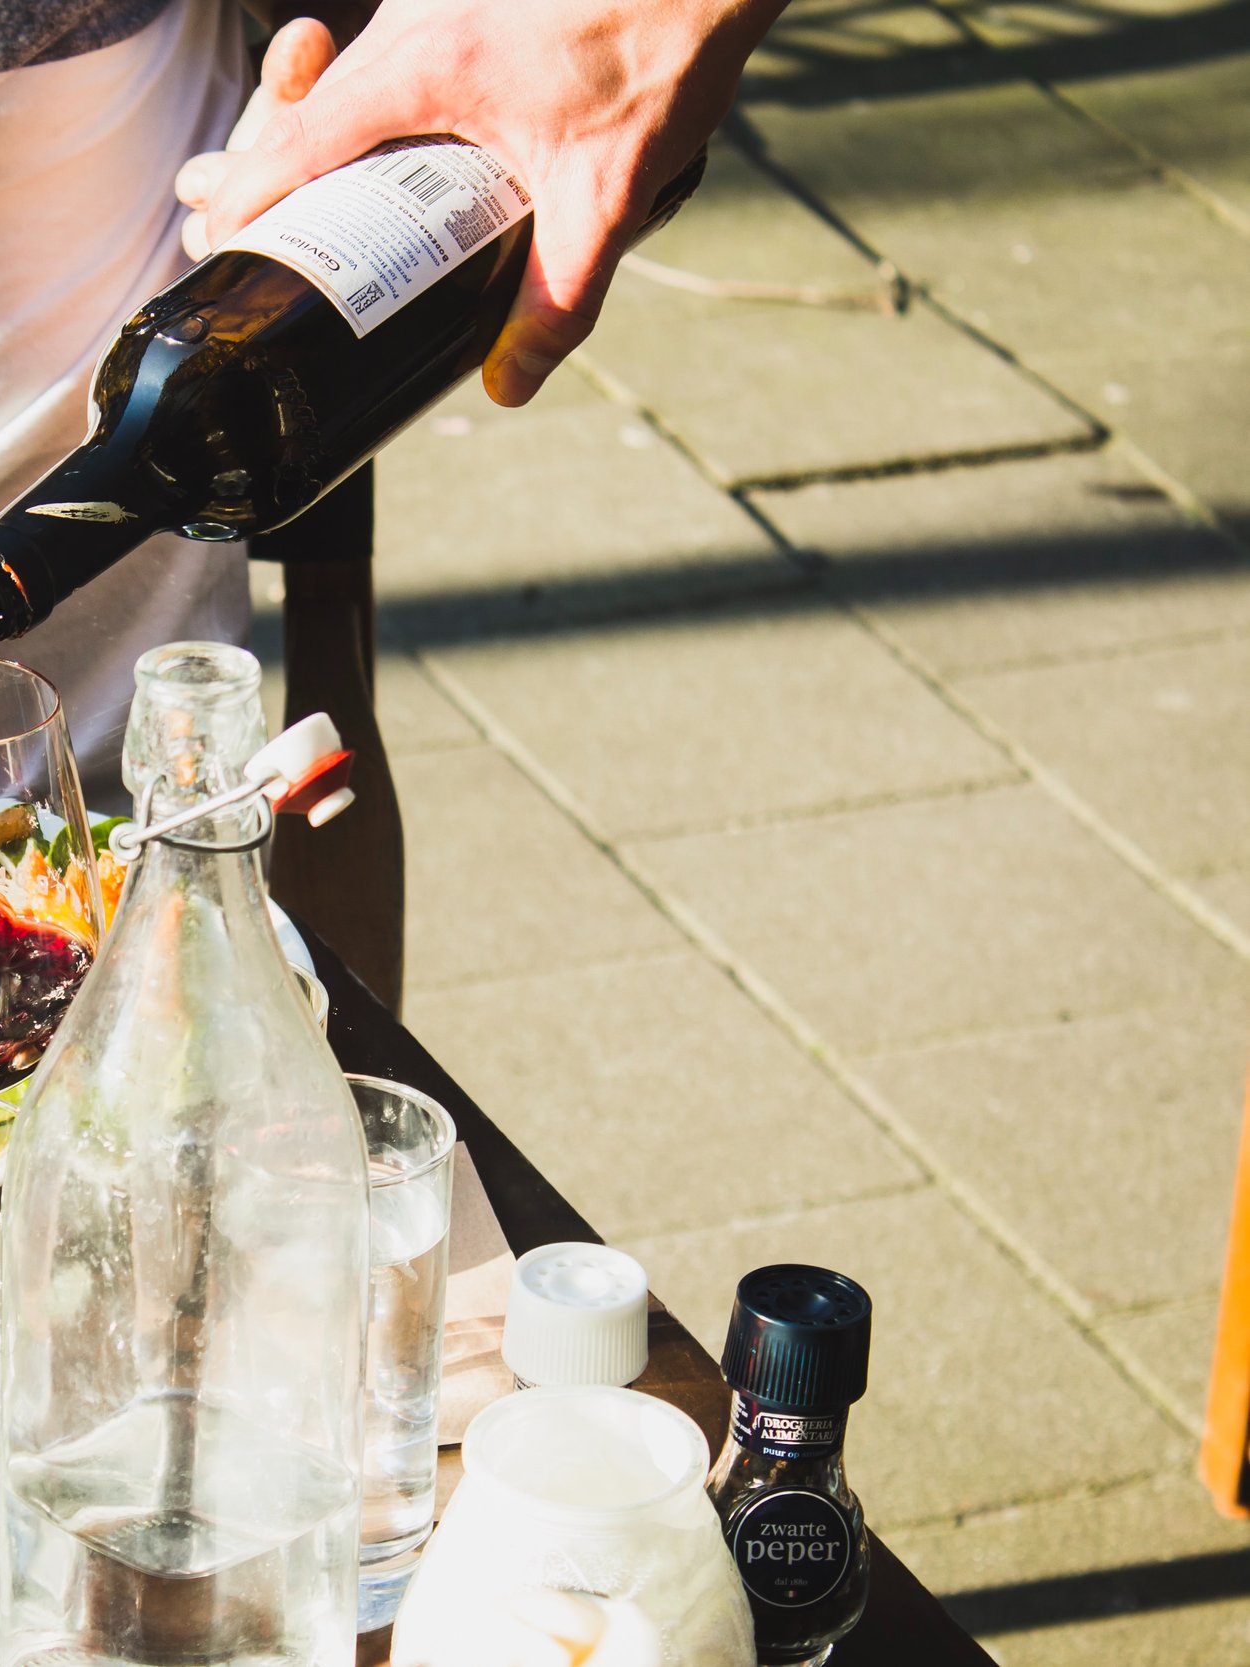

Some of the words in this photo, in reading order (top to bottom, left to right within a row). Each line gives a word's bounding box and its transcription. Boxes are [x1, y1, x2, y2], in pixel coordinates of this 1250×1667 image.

[468, 147, 502, 180] RIBERA
[457, 183, 466, 192] 8
[481, 184, 490, 193] DE
[395, 189, 413, 204] Tinto
[411, 201, 426, 215] Vino
[481, 196, 504, 225] ELABORADO
[489, 194, 509, 221] PEDROSA
[372, 218, 390, 234] copa
[378, 234, 389, 245] de
[388, 232, 397, 241] la
[400, 221, 440, 267] connotaciones
[418, 223, 449, 262] BODEGAS
[278, 231, 339, 272] Gavilán
[323, 241, 357, 271] Variedad
[357, 250, 368, 261] de
[388, 243, 411, 269] nuevas
[401, 245, 420, 267] Llega
[371, 239, 412, 284] permanecido
[367, 259, 400, 299] Procedente
[386, 268, 398, 281] los
[356, 290, 373, 309] BE
[365, 283, 381, 303] RA
[349, 298, 365, 315] RI
[762, 1417, 833, 1430] DROGHERIA
[760, 1428, 834, 1441] ALIMENTARI
[762, 1446, 786, 1457] puur
[787, 1449, 800, 1459] op
[760, 1523, 826, 1537] zwarte
[745, 1539, 841, 1565] peper
[774, 1577, 788, 1586] dal
